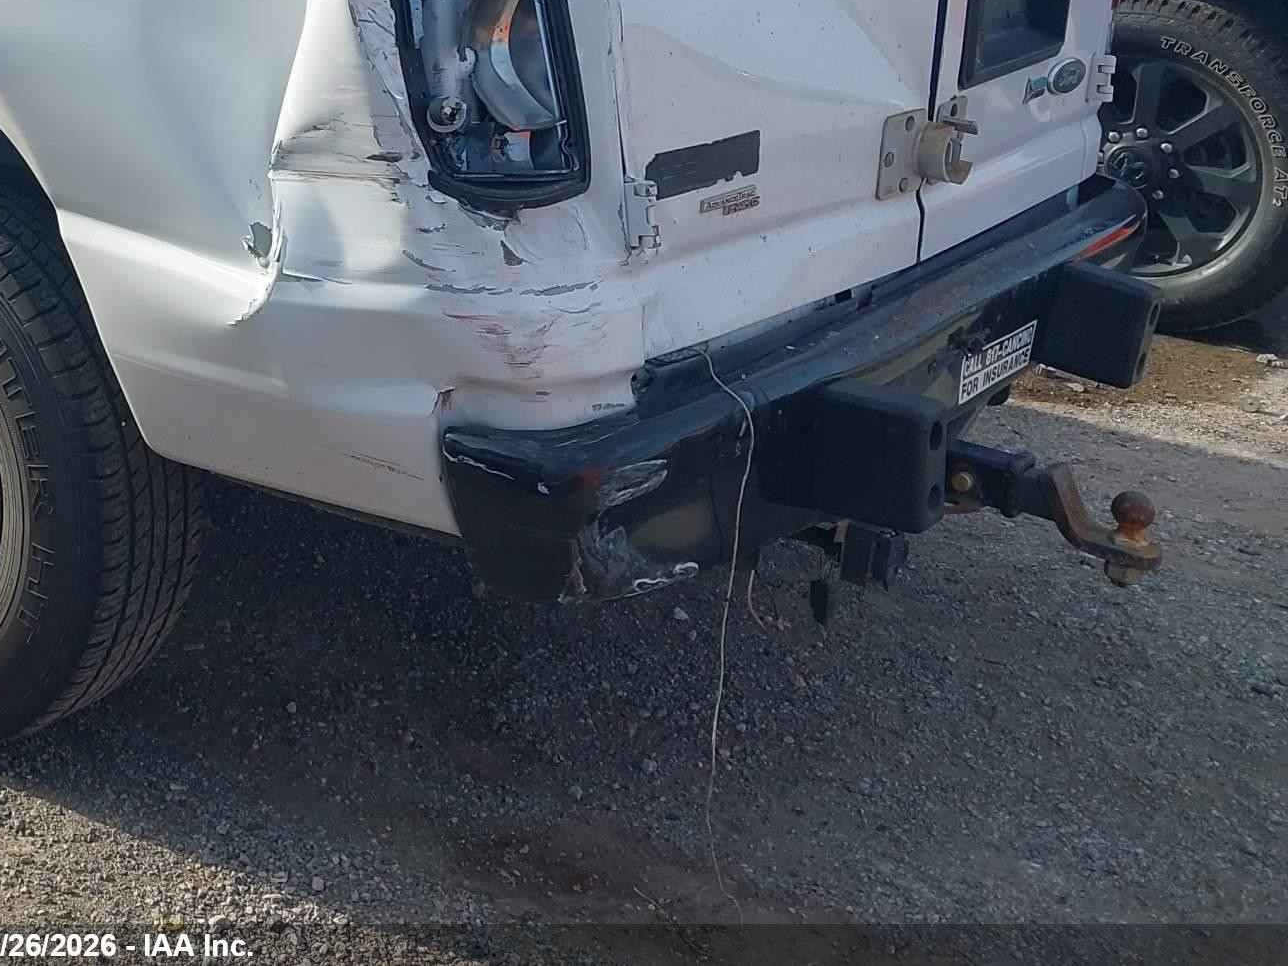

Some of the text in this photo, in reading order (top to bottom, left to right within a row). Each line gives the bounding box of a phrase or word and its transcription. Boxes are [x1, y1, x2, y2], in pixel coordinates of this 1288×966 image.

[1160, 36, 1287, 158] TRANSFORCE
[961, 348, 1031, 400] FOR INSURANCE
[964, 353, 983, 377] CALL
